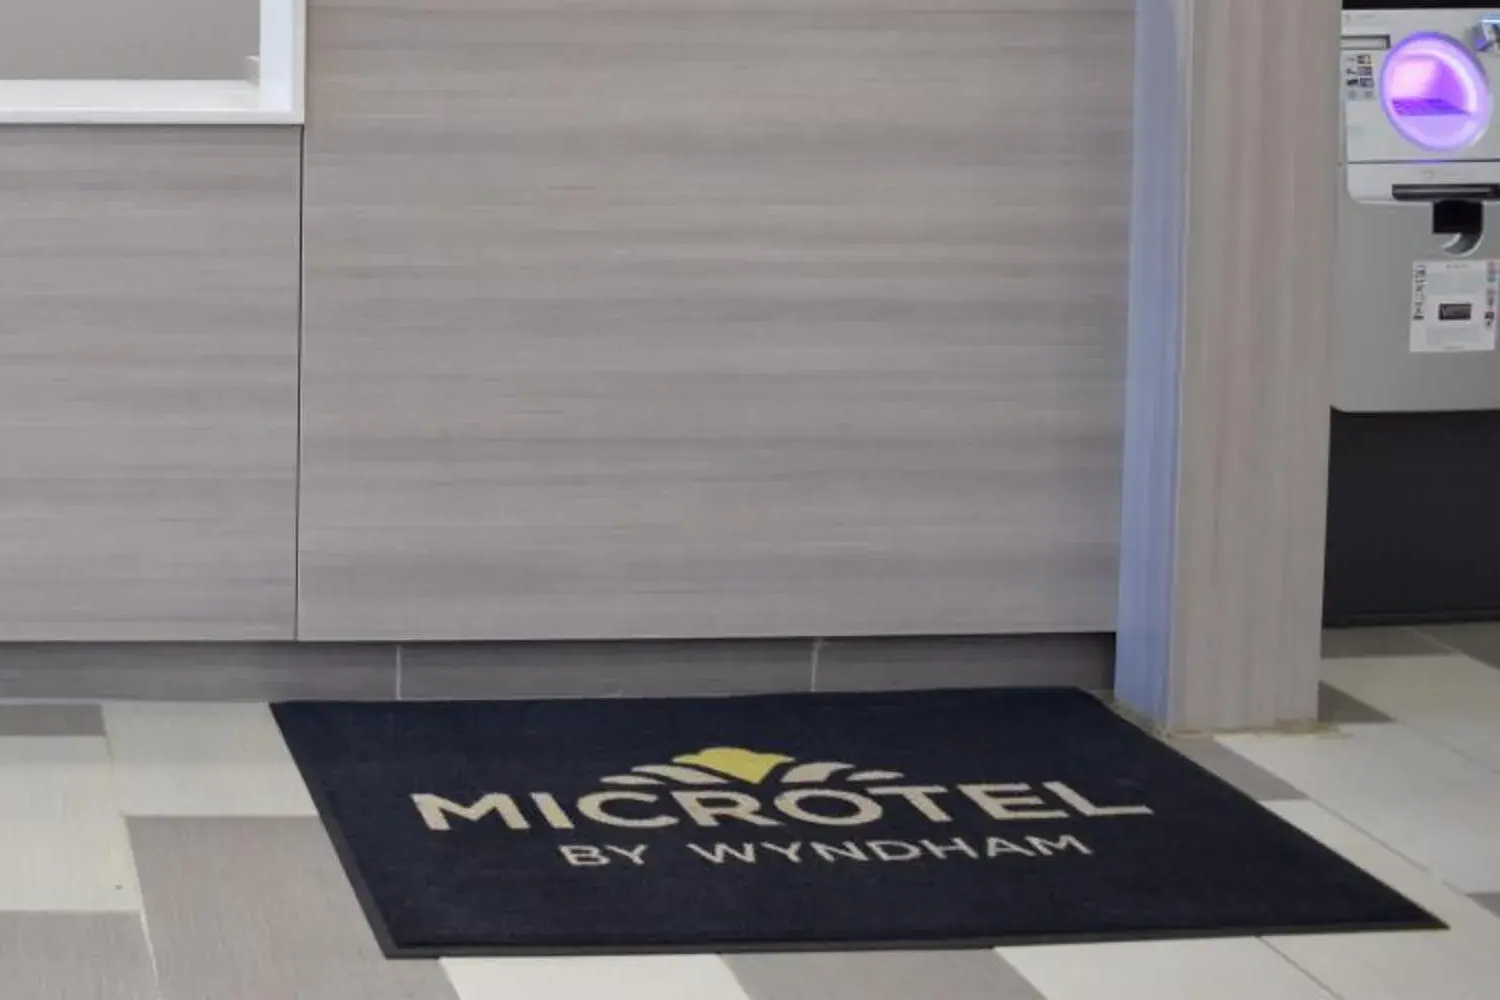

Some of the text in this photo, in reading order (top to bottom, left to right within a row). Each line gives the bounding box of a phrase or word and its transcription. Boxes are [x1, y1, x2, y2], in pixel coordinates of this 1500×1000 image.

[411, 781, 1153, 830] MICROTEL
[559, 834, 1092, 866] BY WYNDHAM
